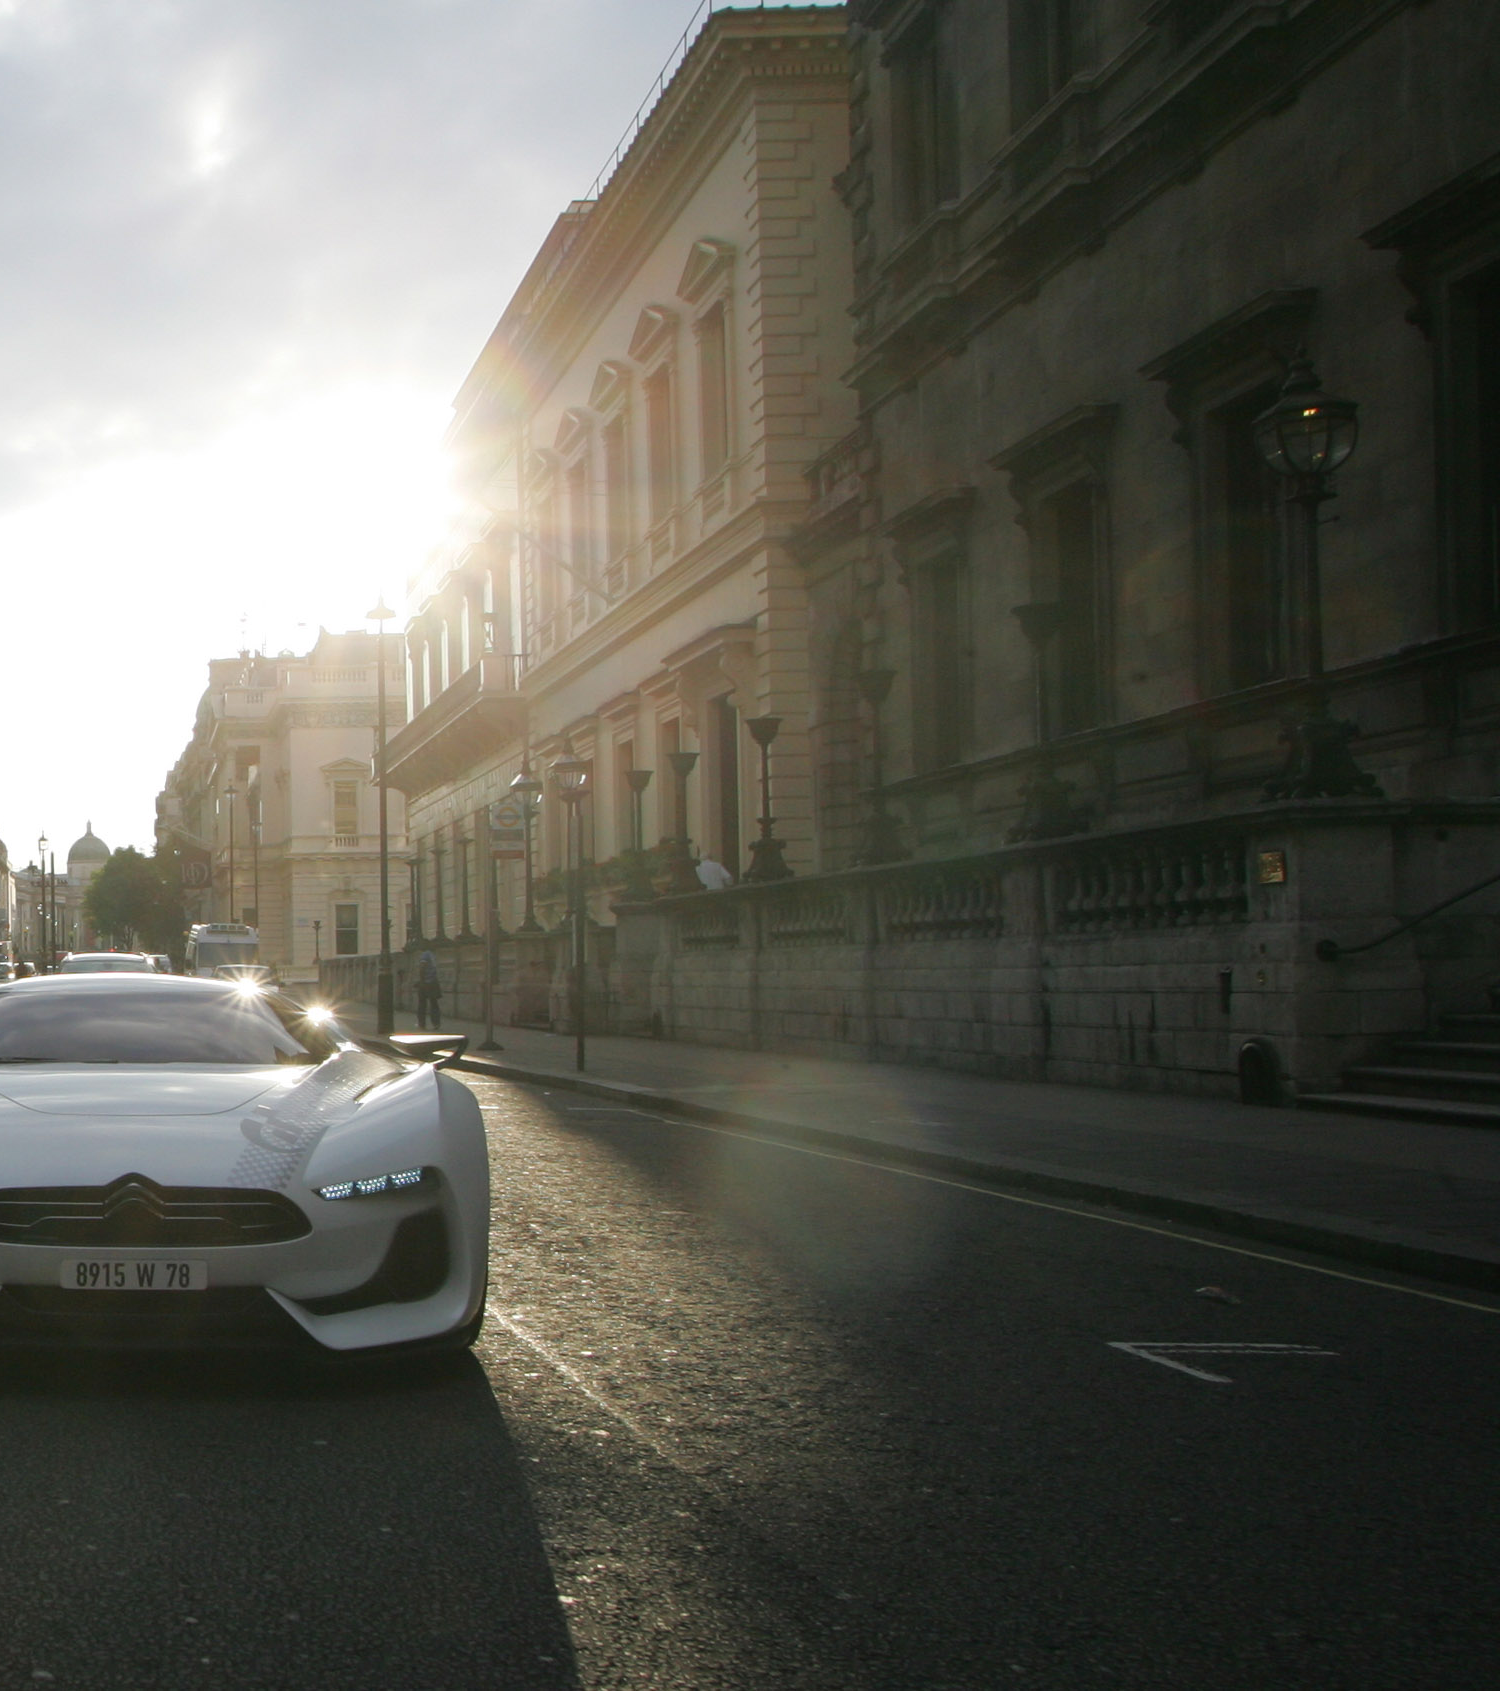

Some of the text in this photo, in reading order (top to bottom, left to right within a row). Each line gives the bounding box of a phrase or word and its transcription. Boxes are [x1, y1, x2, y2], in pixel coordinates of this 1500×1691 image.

[76, 1262, 190, 1288] 8915 W 78
